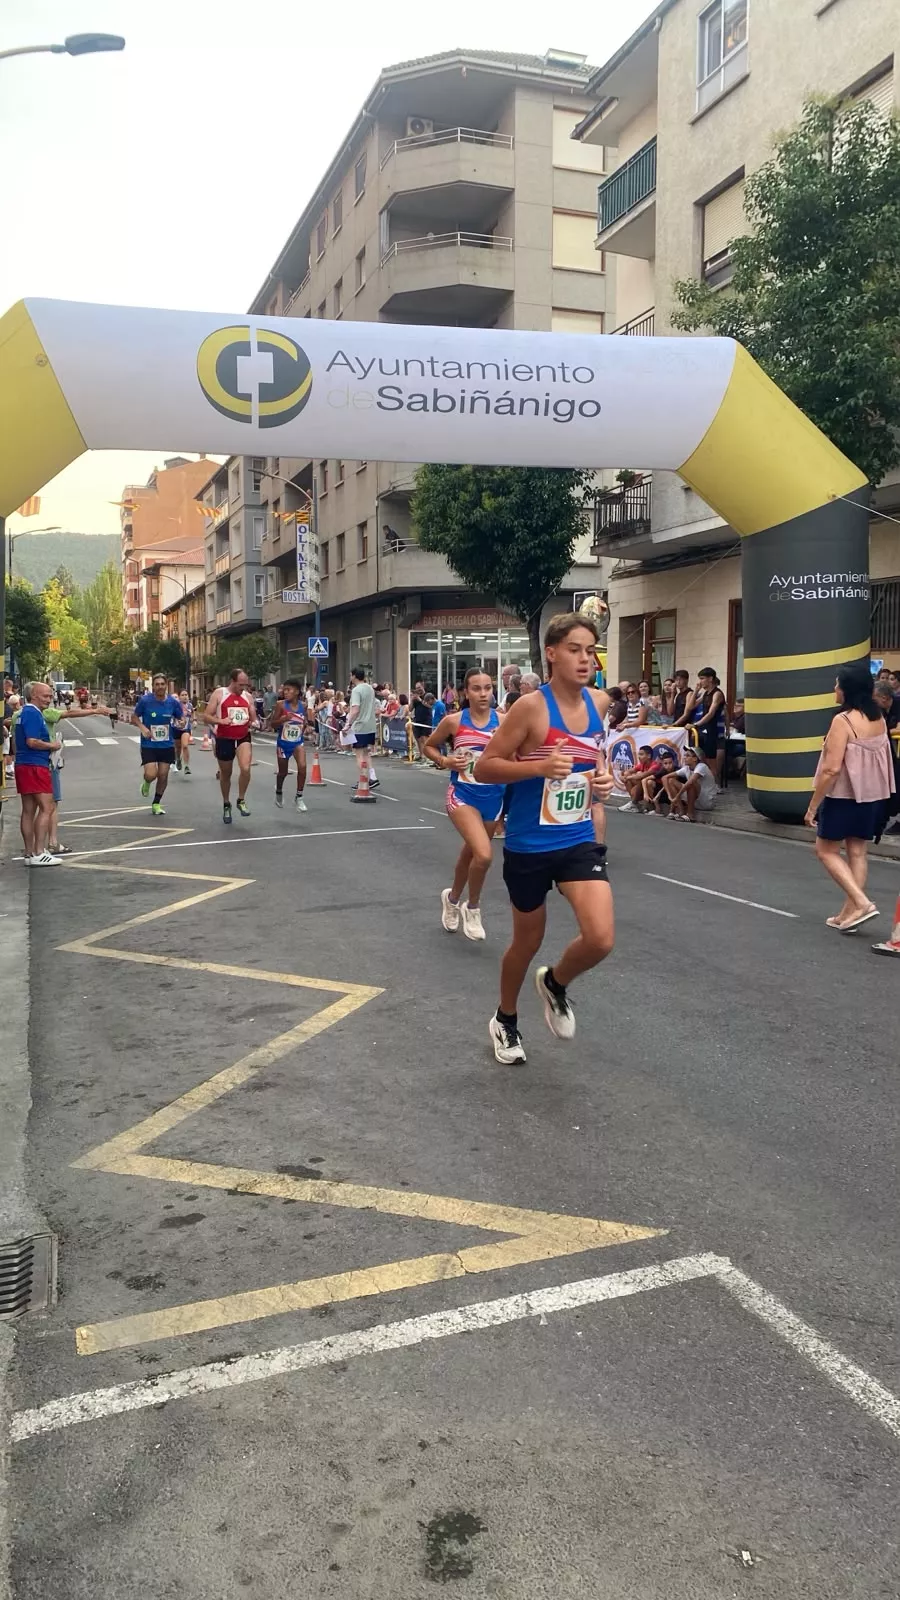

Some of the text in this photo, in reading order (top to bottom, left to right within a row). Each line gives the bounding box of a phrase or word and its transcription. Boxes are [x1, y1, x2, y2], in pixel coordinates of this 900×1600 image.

[326, 350, 595, 384] Ayuntamiento
[423, 615, 447, 627] BAZAR
[448, 614, 476, 626] REGALO
[555, 789, 585, 811] 150
